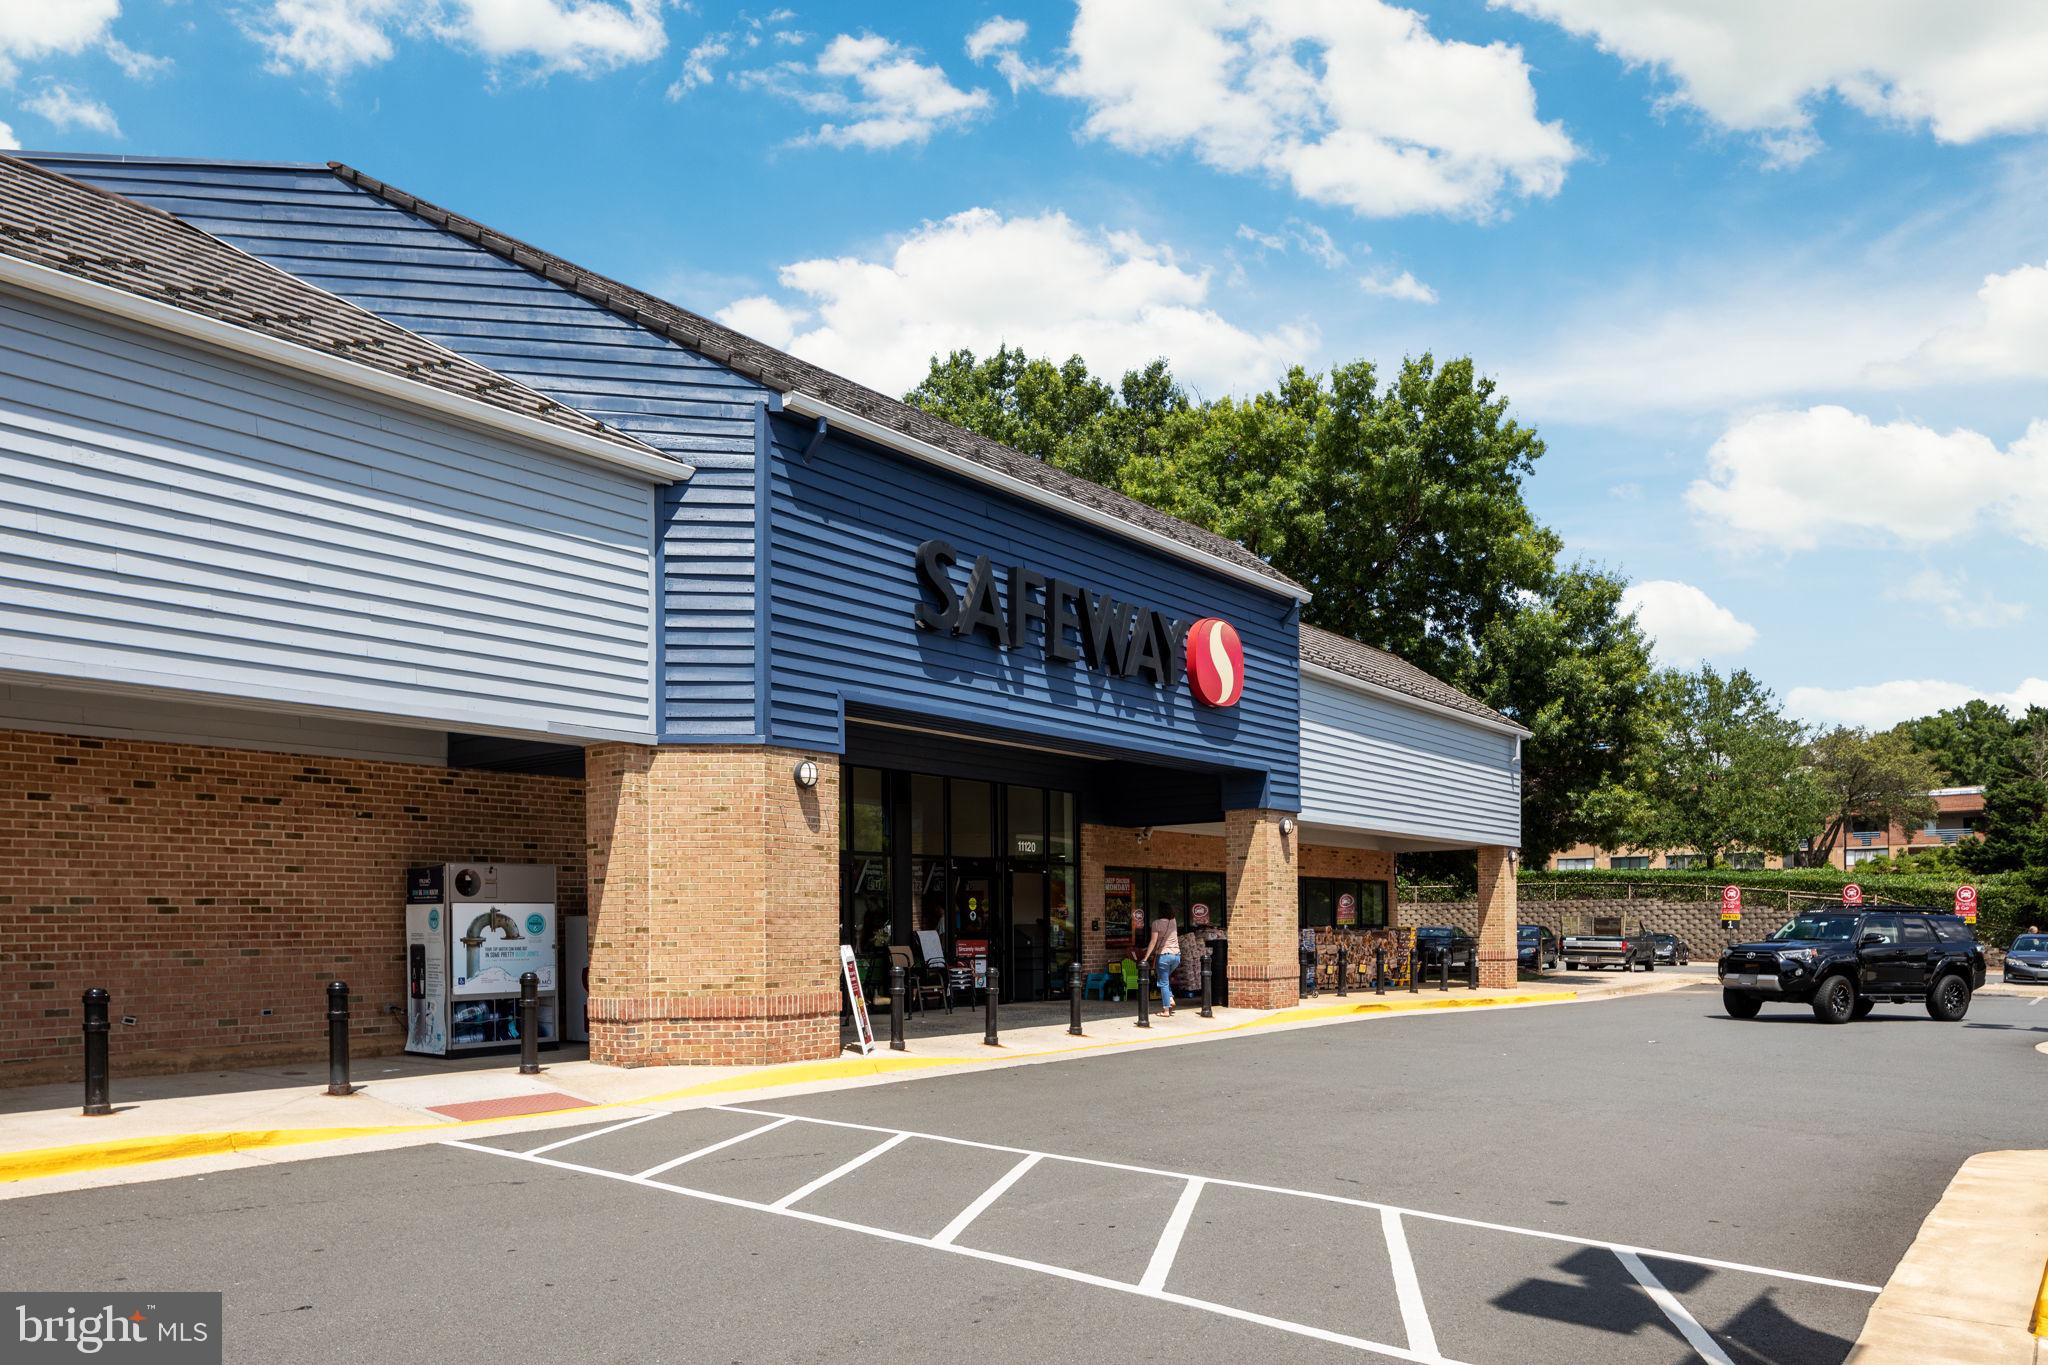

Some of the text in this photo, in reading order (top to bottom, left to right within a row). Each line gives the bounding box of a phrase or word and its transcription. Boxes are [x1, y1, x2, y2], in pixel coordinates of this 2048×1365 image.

[914, 539, 1189, 686] SAFEWAY
[1018, 840, 1036, 853] 11120
[1727, 920, 1733, 929] 1
